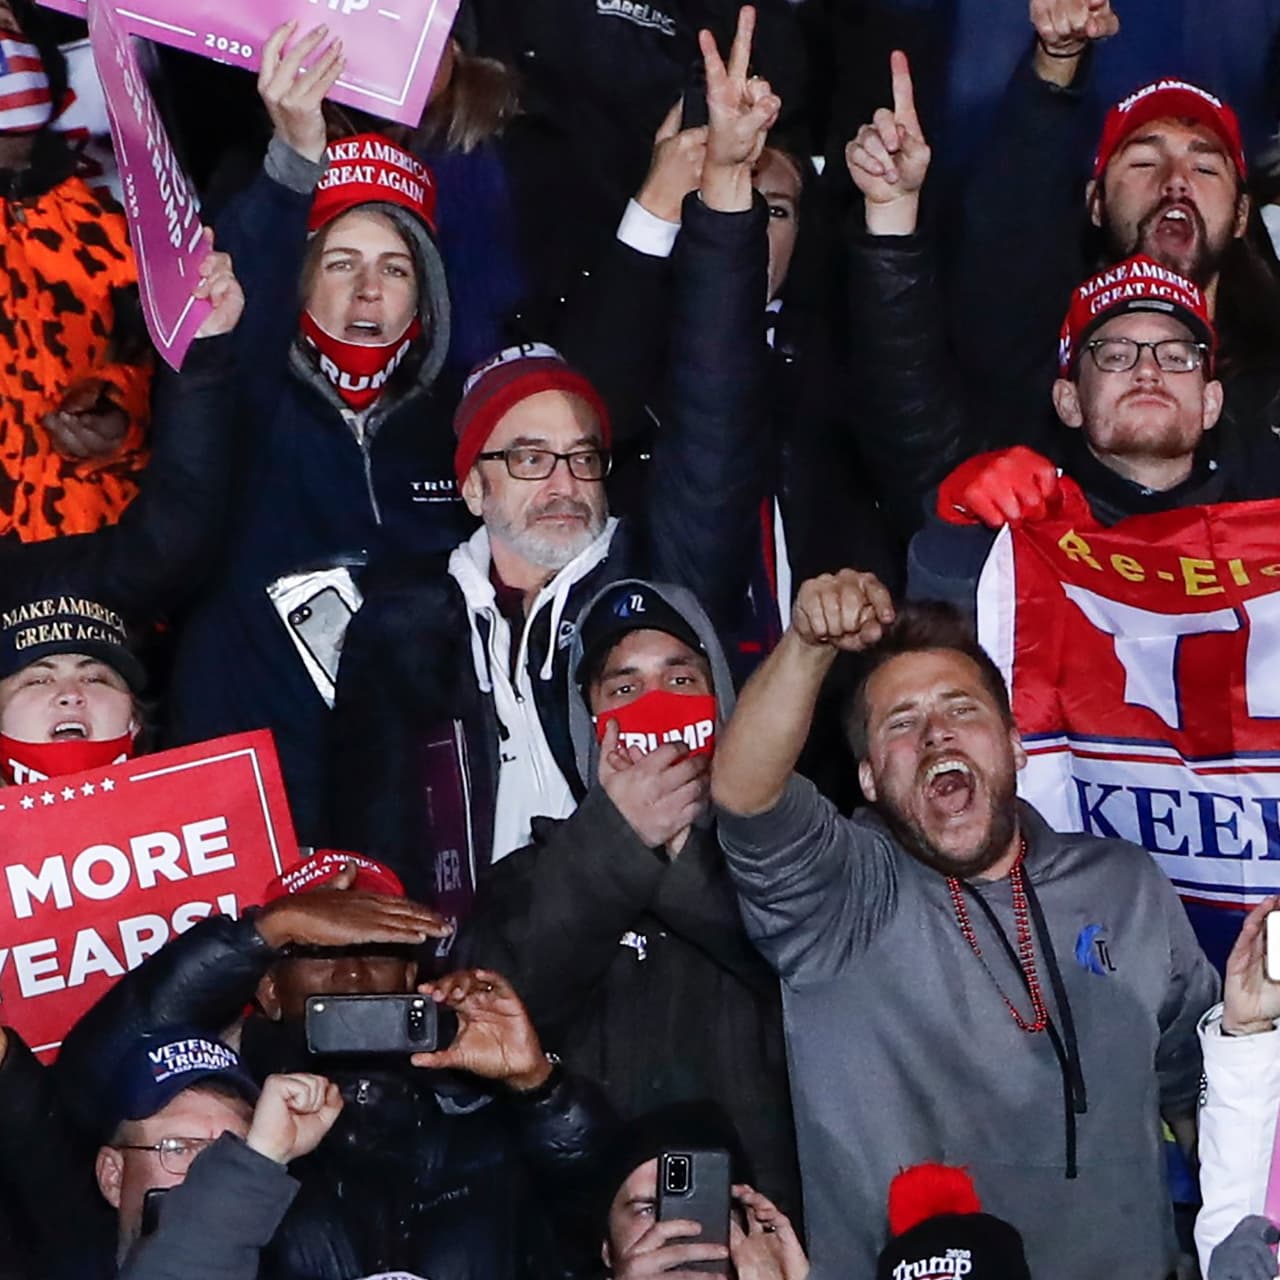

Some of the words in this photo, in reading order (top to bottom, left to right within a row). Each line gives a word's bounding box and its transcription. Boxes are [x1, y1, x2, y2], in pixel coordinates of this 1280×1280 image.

[204, 33, 254, 58] 2020
[317, 148, 369, 190] GREAT
[371, 166, 424, 204] AGAIN
[326, 142, 360, 161] AKE
[360, 140, 432, 187] AMERICA
[123, 174, 140, 218] 2020
[1078, 269, 1127, 300] MAKE
[1128, 261, 1201, 306] AMERICA
[1089, 282, 1145, 314] GREAT
[411, 480, 452, 491] TRU
[2, 601, 56, 631] MAKE
[57, 595, 127, 637] AMERICA
[15, 622, 73, 651] GREAT
[5, 818, 236, 918] MORE
[278, 860, 319, 888] MAKE
